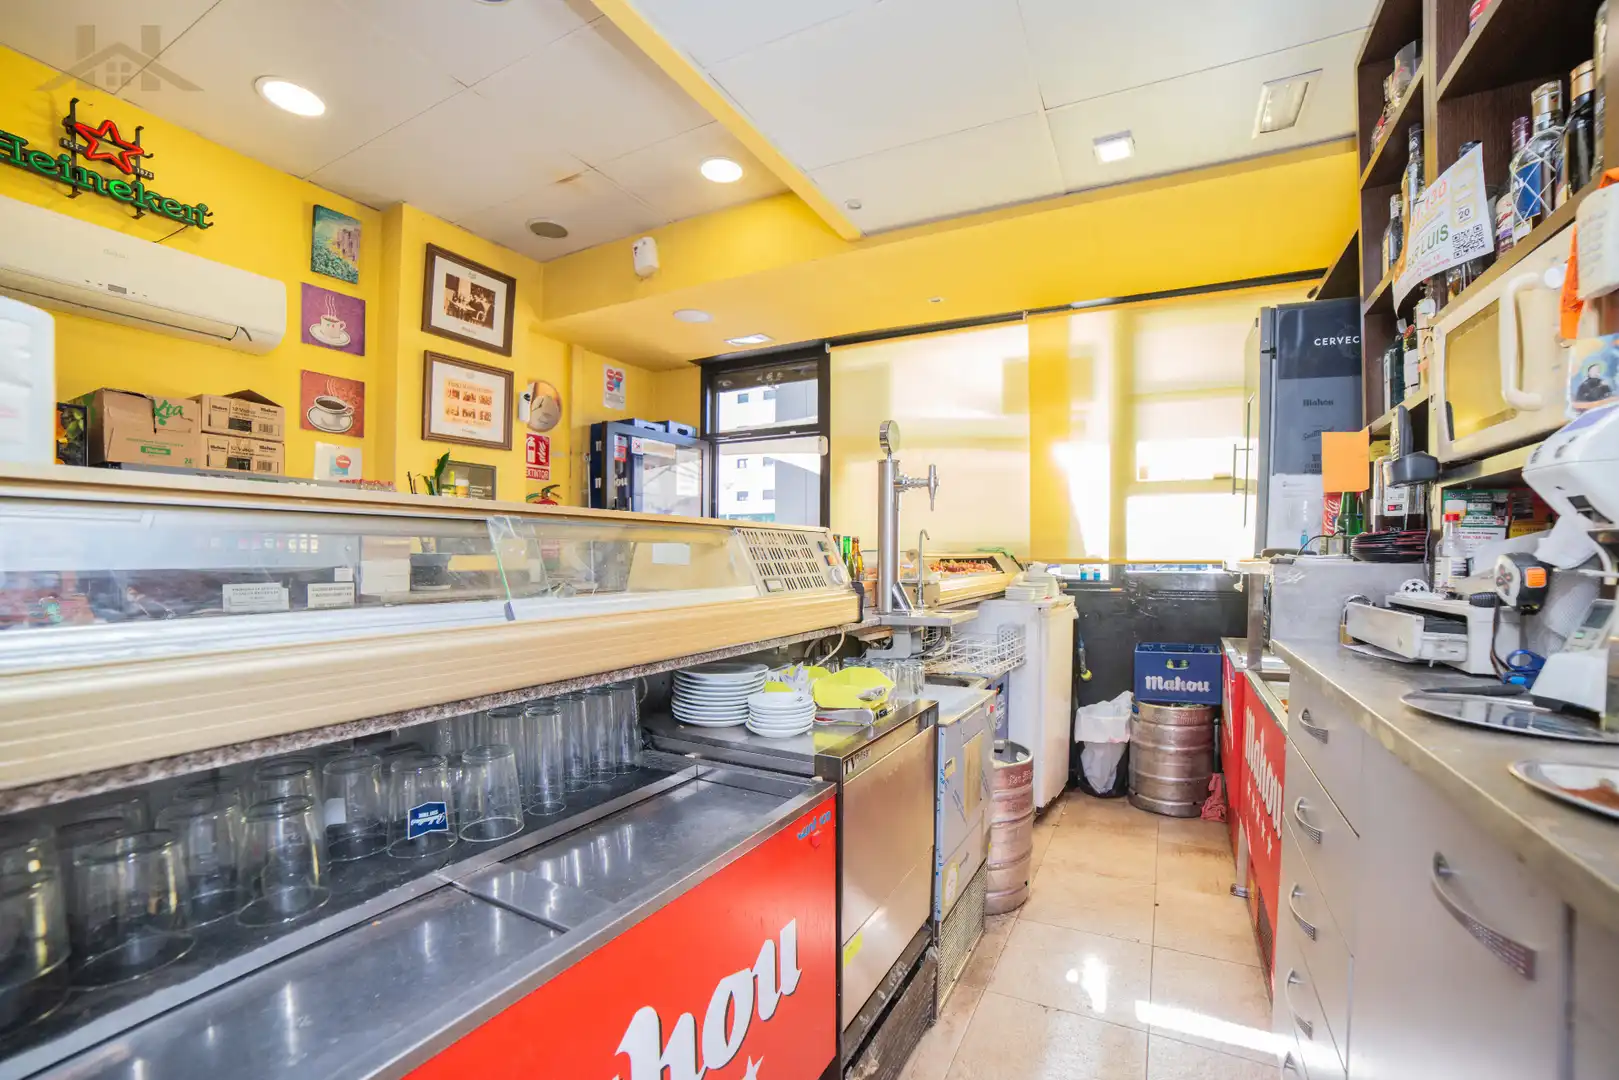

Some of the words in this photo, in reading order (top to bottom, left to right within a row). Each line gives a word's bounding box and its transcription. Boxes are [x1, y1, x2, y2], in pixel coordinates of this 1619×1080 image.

[0, 129, 209, 229] Heineken
[1314, 336, 1360, 346] CERVEC
[1145, 675, 1210, 693] Mahou
[1244, 706, 1283, 840] Mahou
